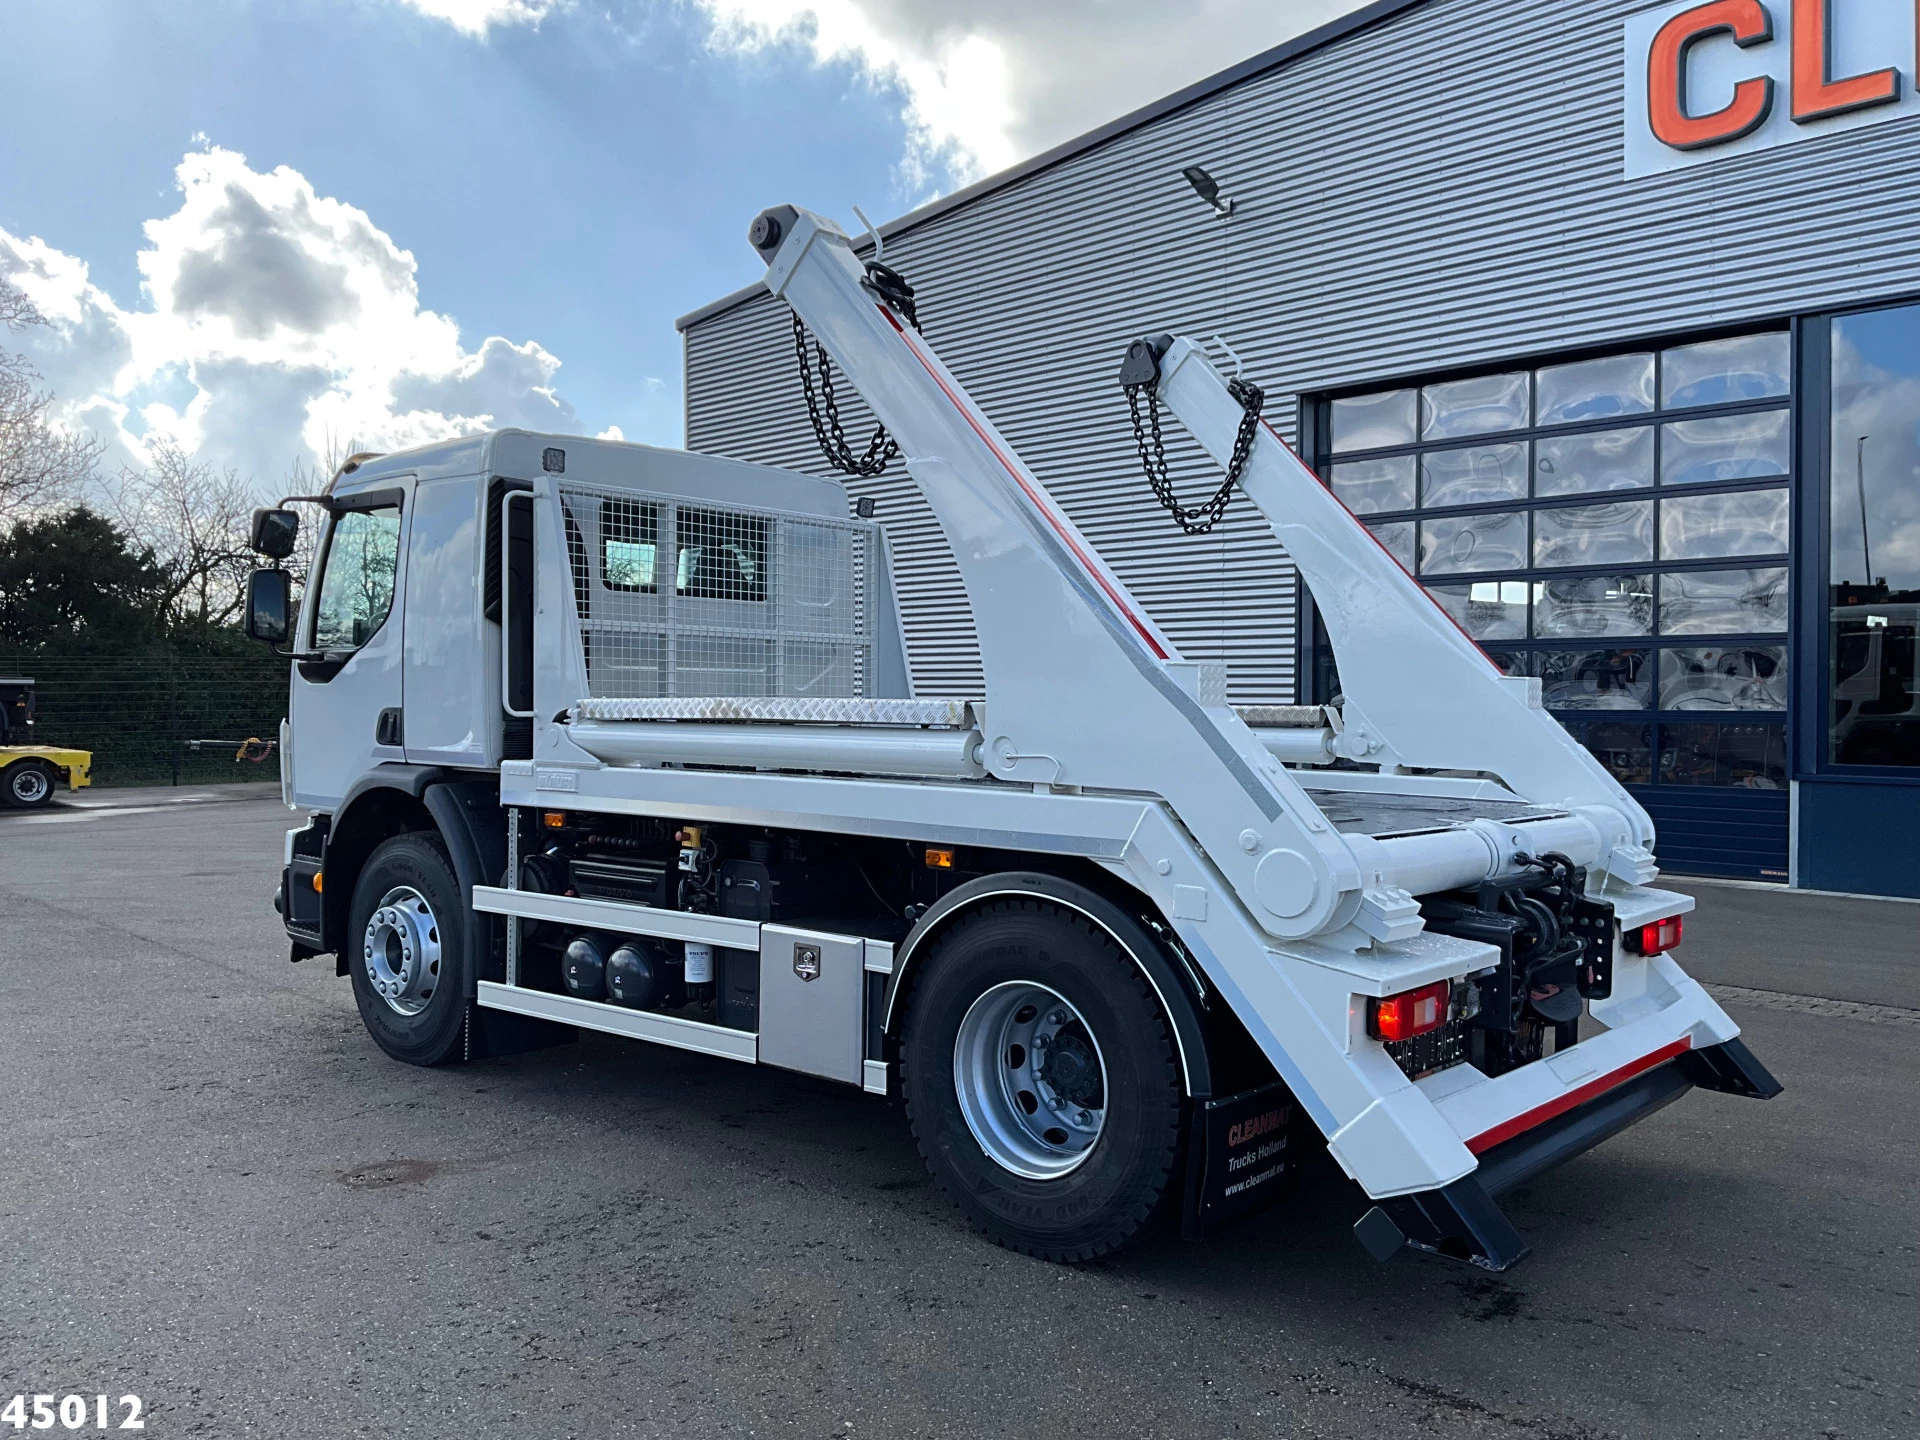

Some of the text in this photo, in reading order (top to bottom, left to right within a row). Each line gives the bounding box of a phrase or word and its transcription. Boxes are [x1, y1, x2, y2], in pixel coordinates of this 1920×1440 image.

[1647, 0, 1920, 151] CL
[1228, 1135, 1288, 1172] Trucks Holland
[1225, 1162, 1285, 1197] www.cleanmat.eu
